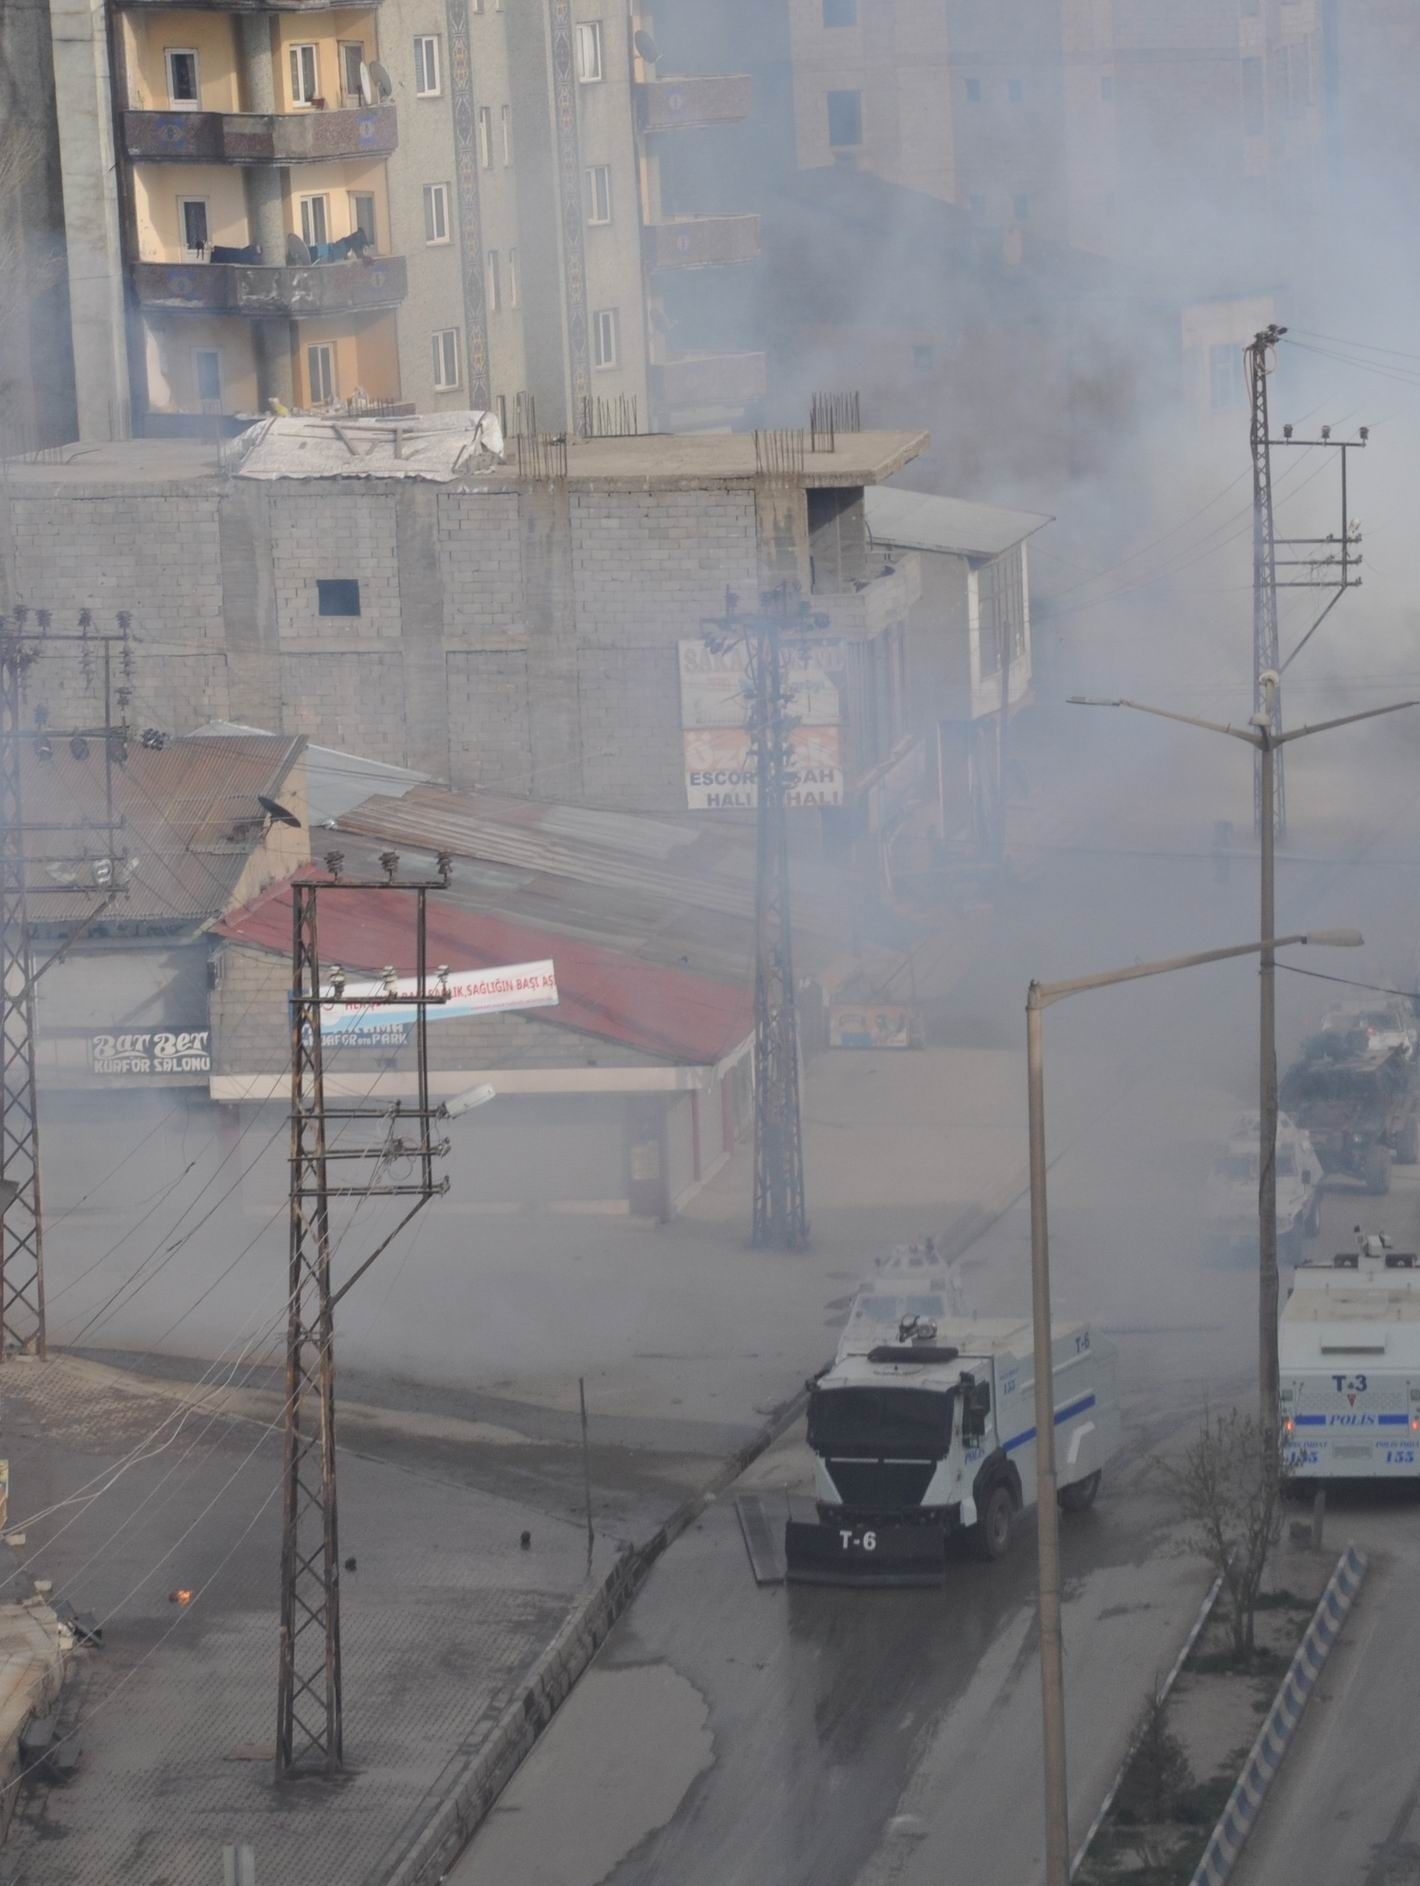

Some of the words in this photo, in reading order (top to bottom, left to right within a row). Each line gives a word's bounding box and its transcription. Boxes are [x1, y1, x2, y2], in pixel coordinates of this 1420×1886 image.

[153, 1056, 210, 1072] SALONU
[1385, 1450, 1415, 1463] 155
[839, 1530, 877, 1551] T-6
